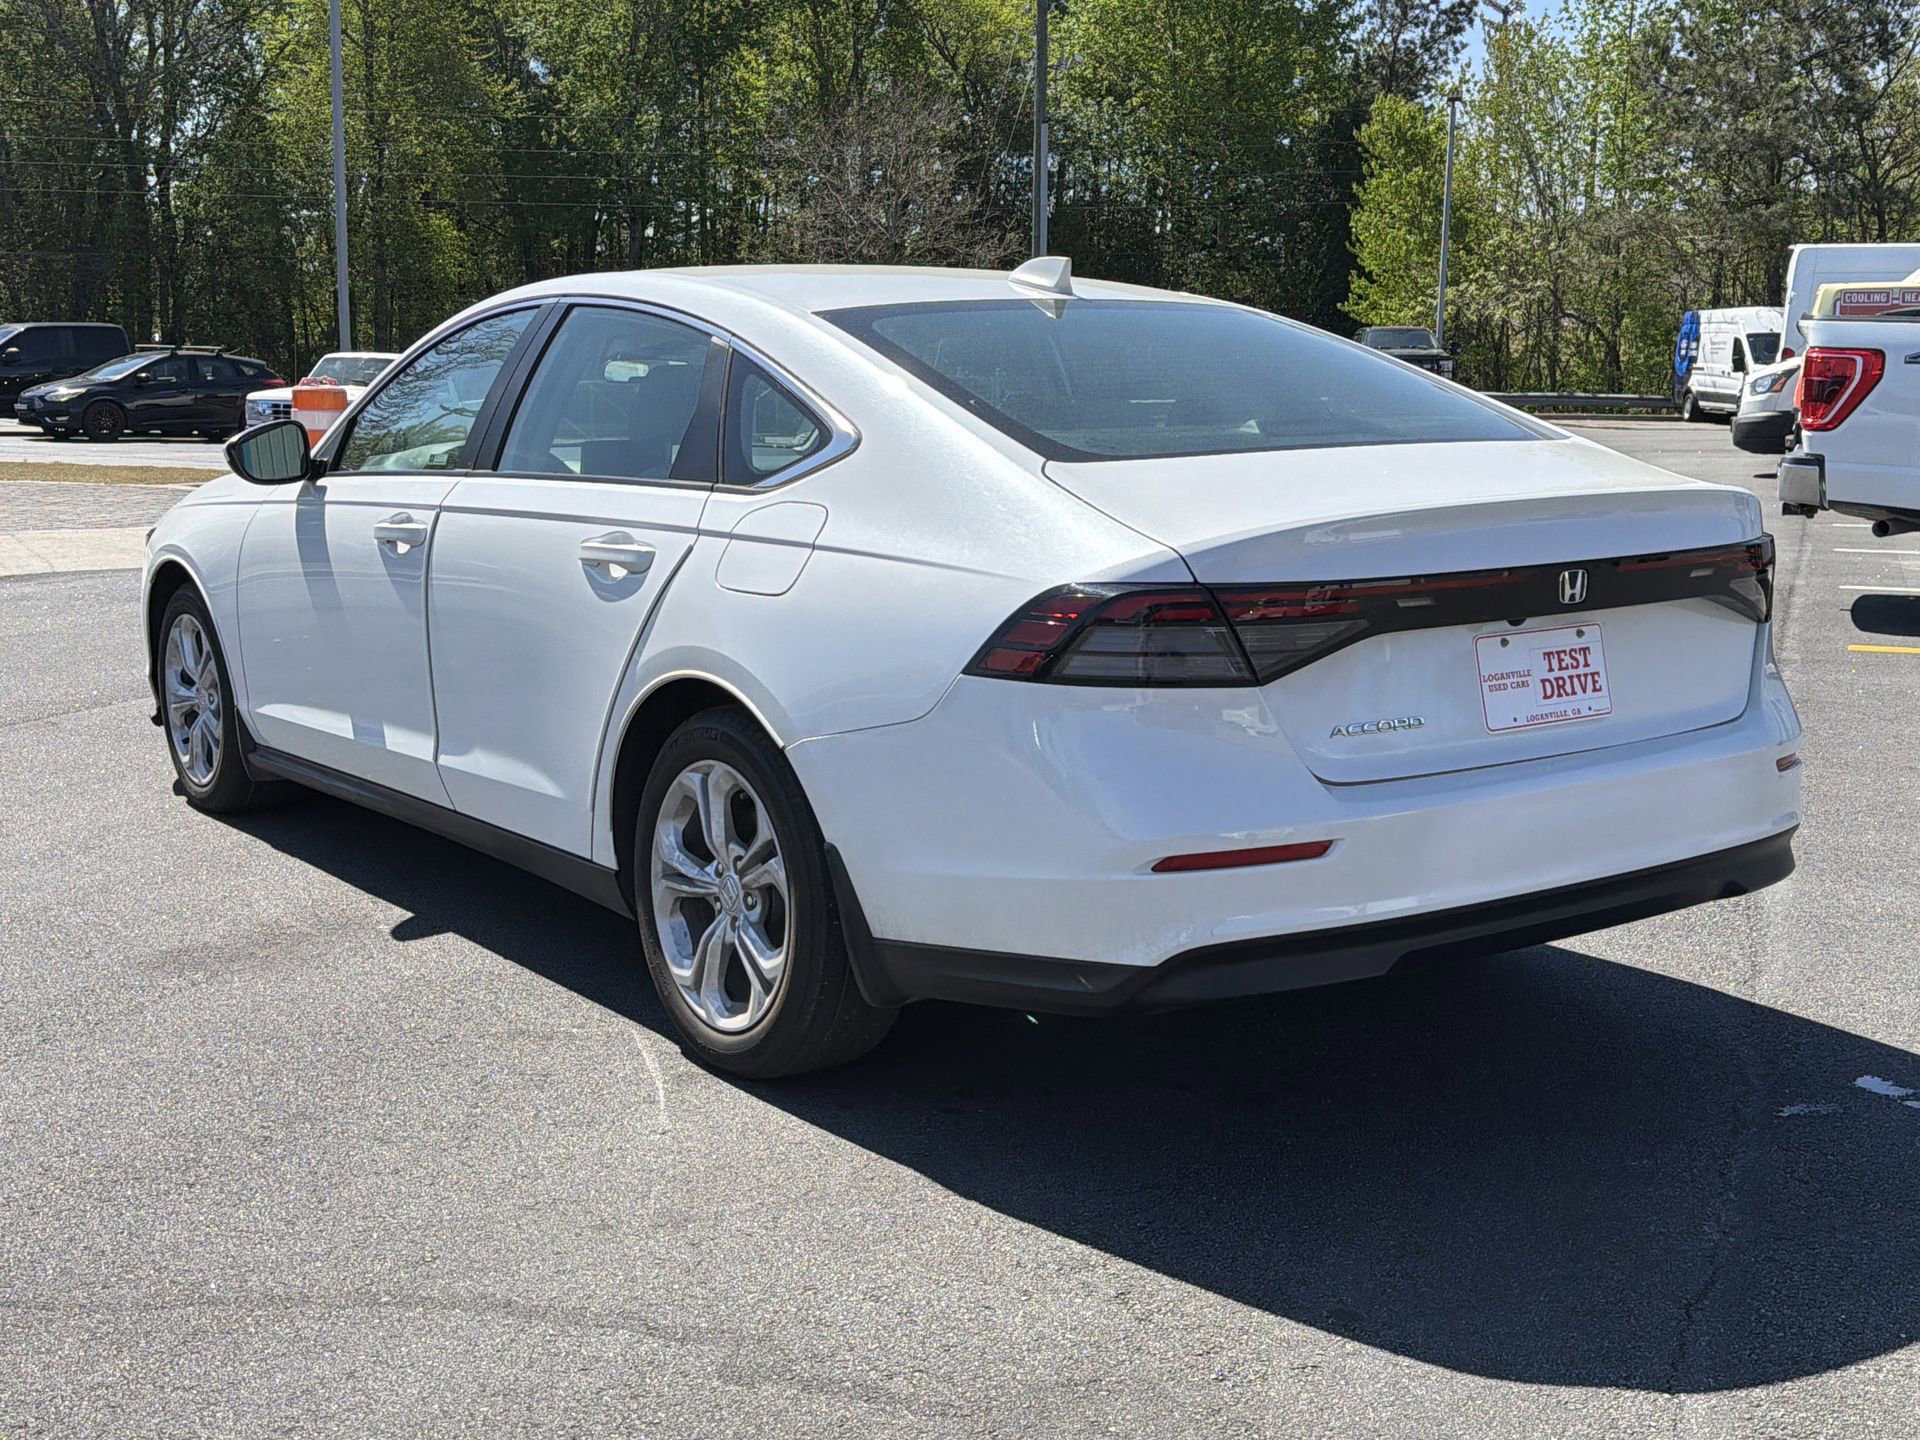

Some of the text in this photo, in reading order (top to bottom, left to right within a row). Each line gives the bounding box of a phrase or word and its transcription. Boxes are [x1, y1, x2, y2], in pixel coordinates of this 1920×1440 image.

[1845, 293, 1887, 302] COOLING
[1543, 647, 1590, 672] TEST
[1483, 669, 1531, 682] LOGANVILLE
[1488, 680, 1530, 693] USED CARS
[1540, 671, 1602, 700] DRIVE
[1526, 710, 1570, 722] LOGANVILLE,
[1572, 708, 1582, 716] GA
[1329, 716, 1424, 738] ACCORD
